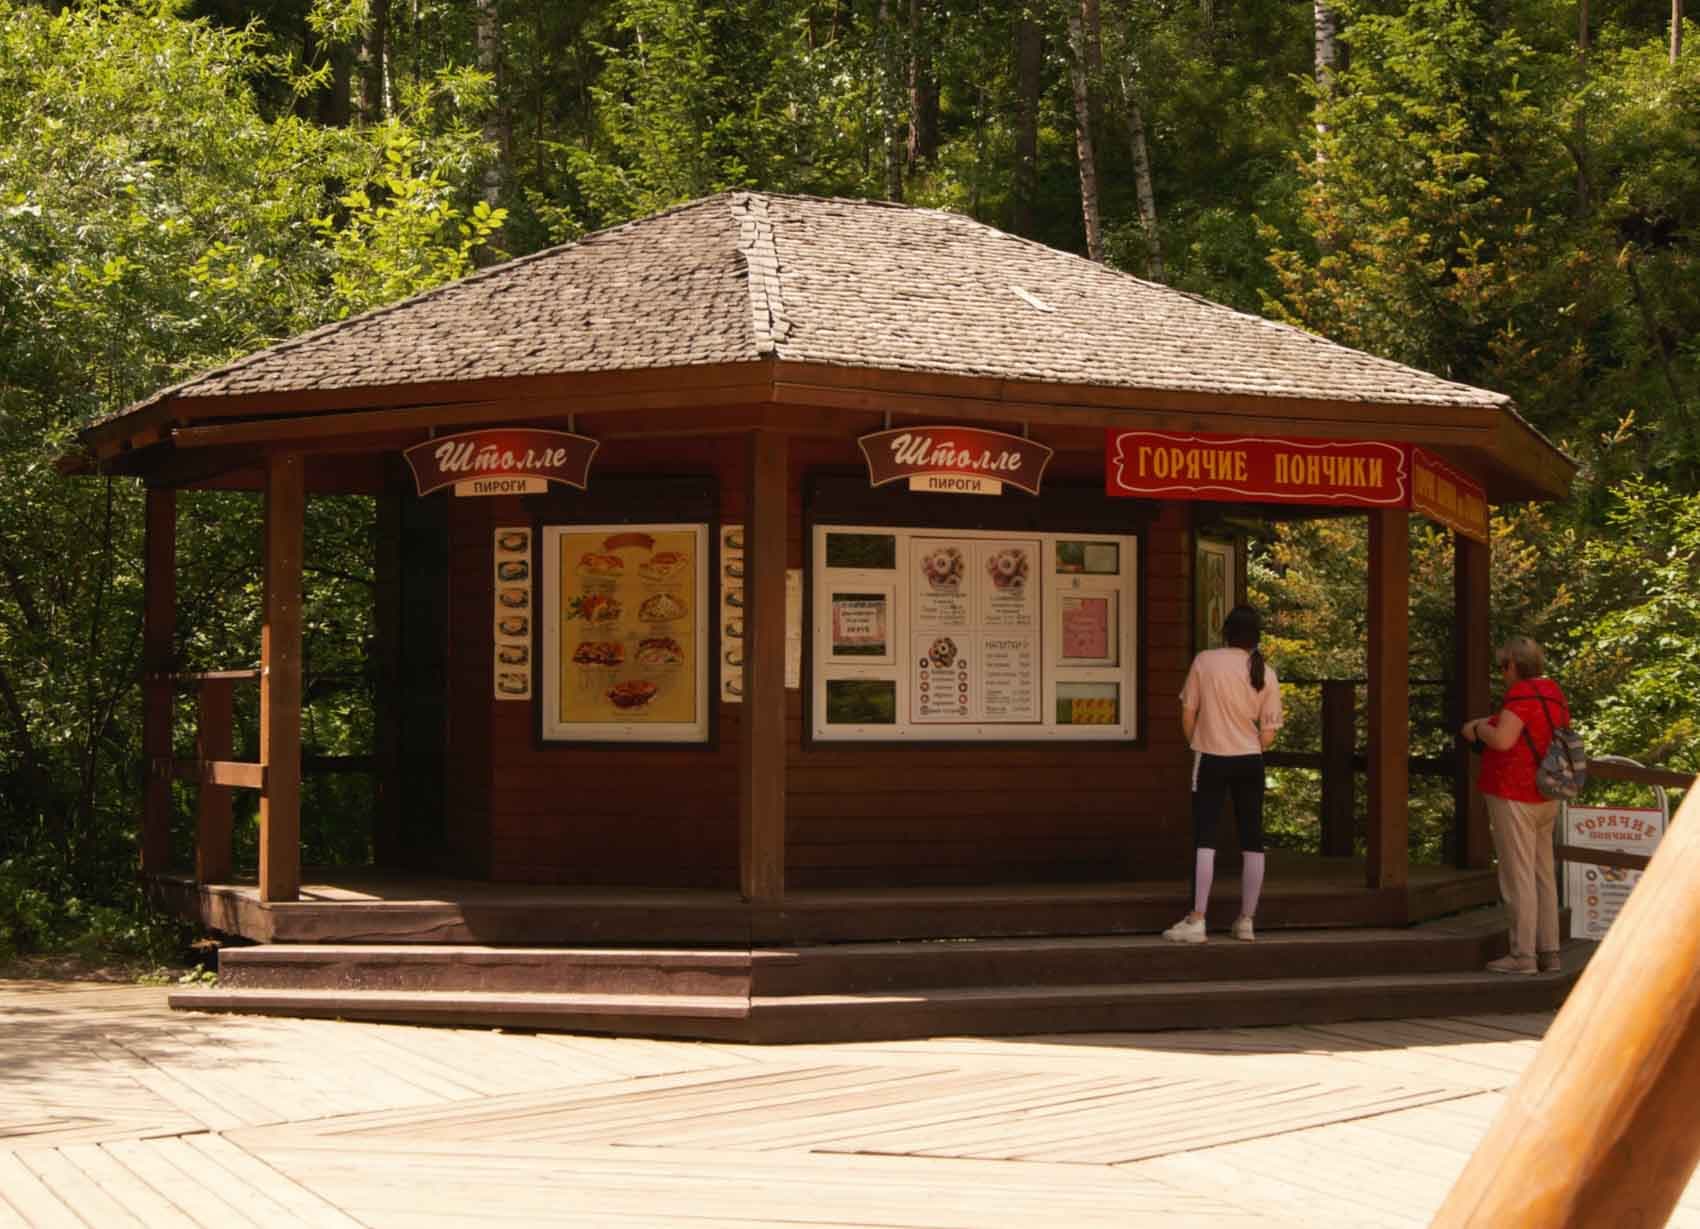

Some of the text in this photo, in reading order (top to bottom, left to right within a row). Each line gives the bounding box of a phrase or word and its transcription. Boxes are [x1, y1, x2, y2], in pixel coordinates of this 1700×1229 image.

[435, 440, 567, 472] Штолле
[890, 432, 1022, 471] Штолле
[1137, 445, 1384, 488] ГОРЯЧИЕ ПОНЧИКИ
[474, 479, 527, 494] ПИРОГИ
[928, 476, 982, 491] ПИРОГИ
[1574, 815, 1657, 838] ГОРЯЧИЕ
